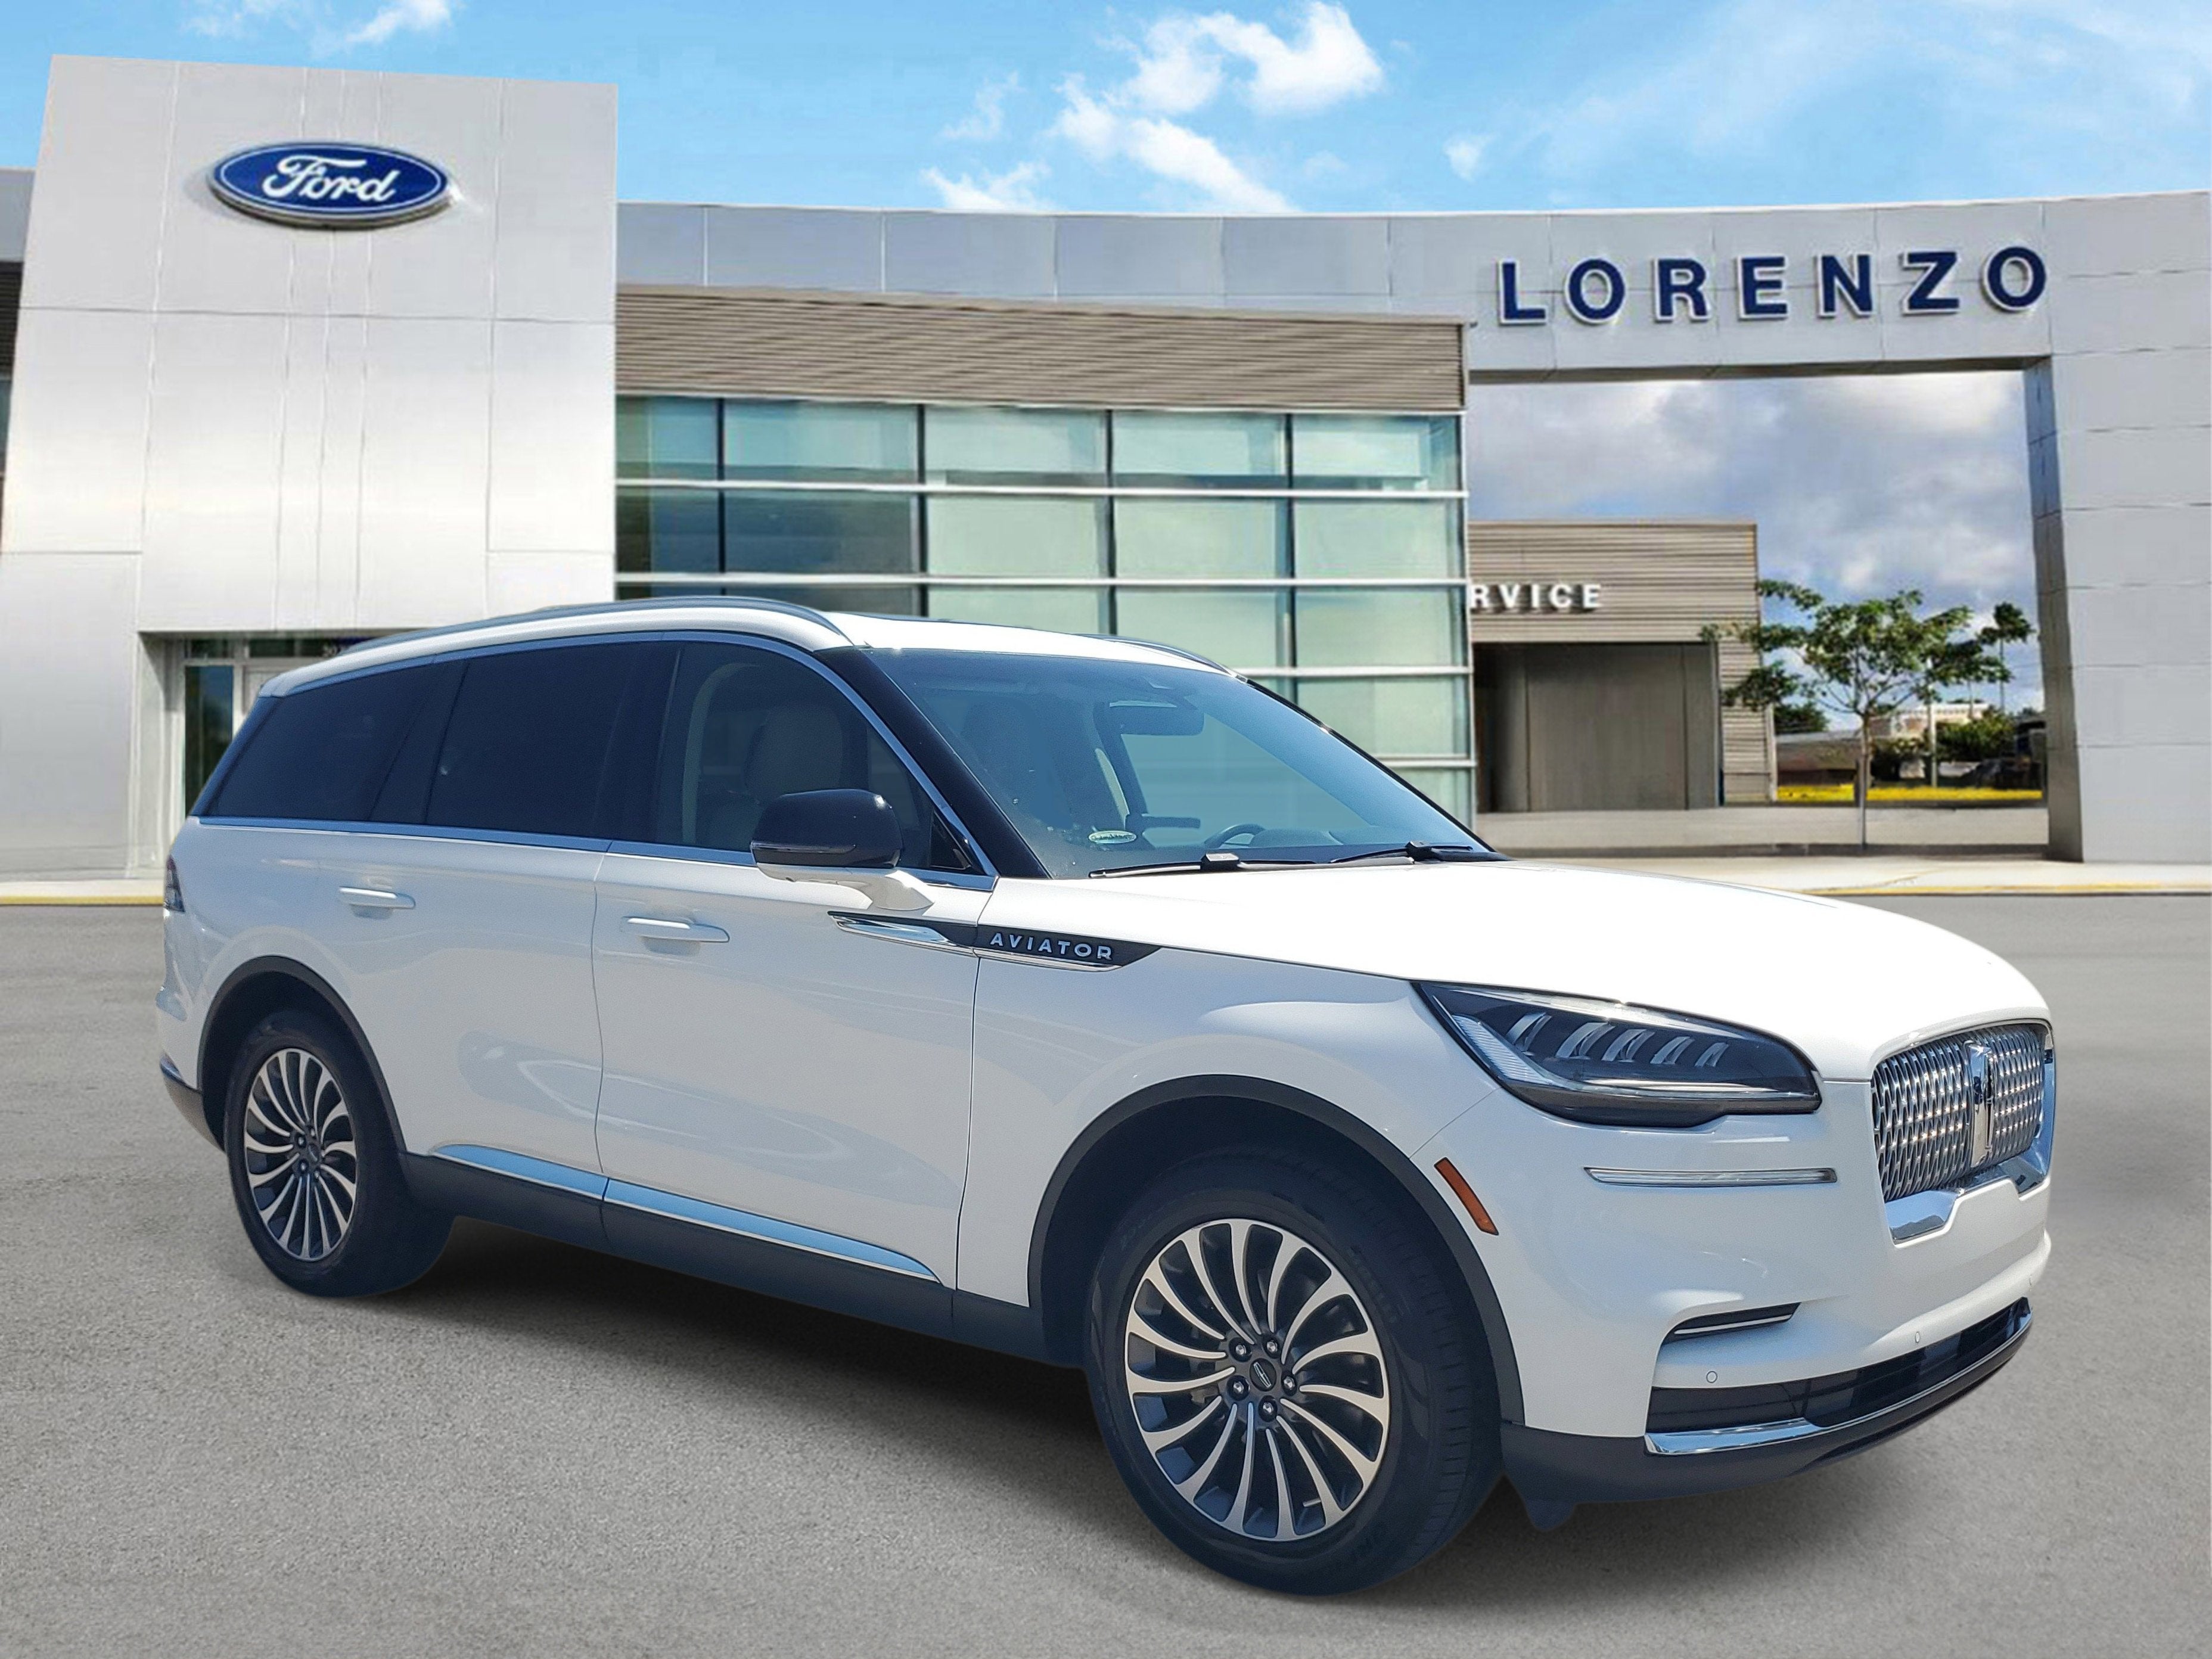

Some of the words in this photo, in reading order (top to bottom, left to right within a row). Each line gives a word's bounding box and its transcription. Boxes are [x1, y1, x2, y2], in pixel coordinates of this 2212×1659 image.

[262, 155, 400, 201] Ford
[1498, 247, 2046, 325] LORENZO
[1470, 584, 1601, 608] RVICE
[990, 933, 1113, 960] AVIATOR
